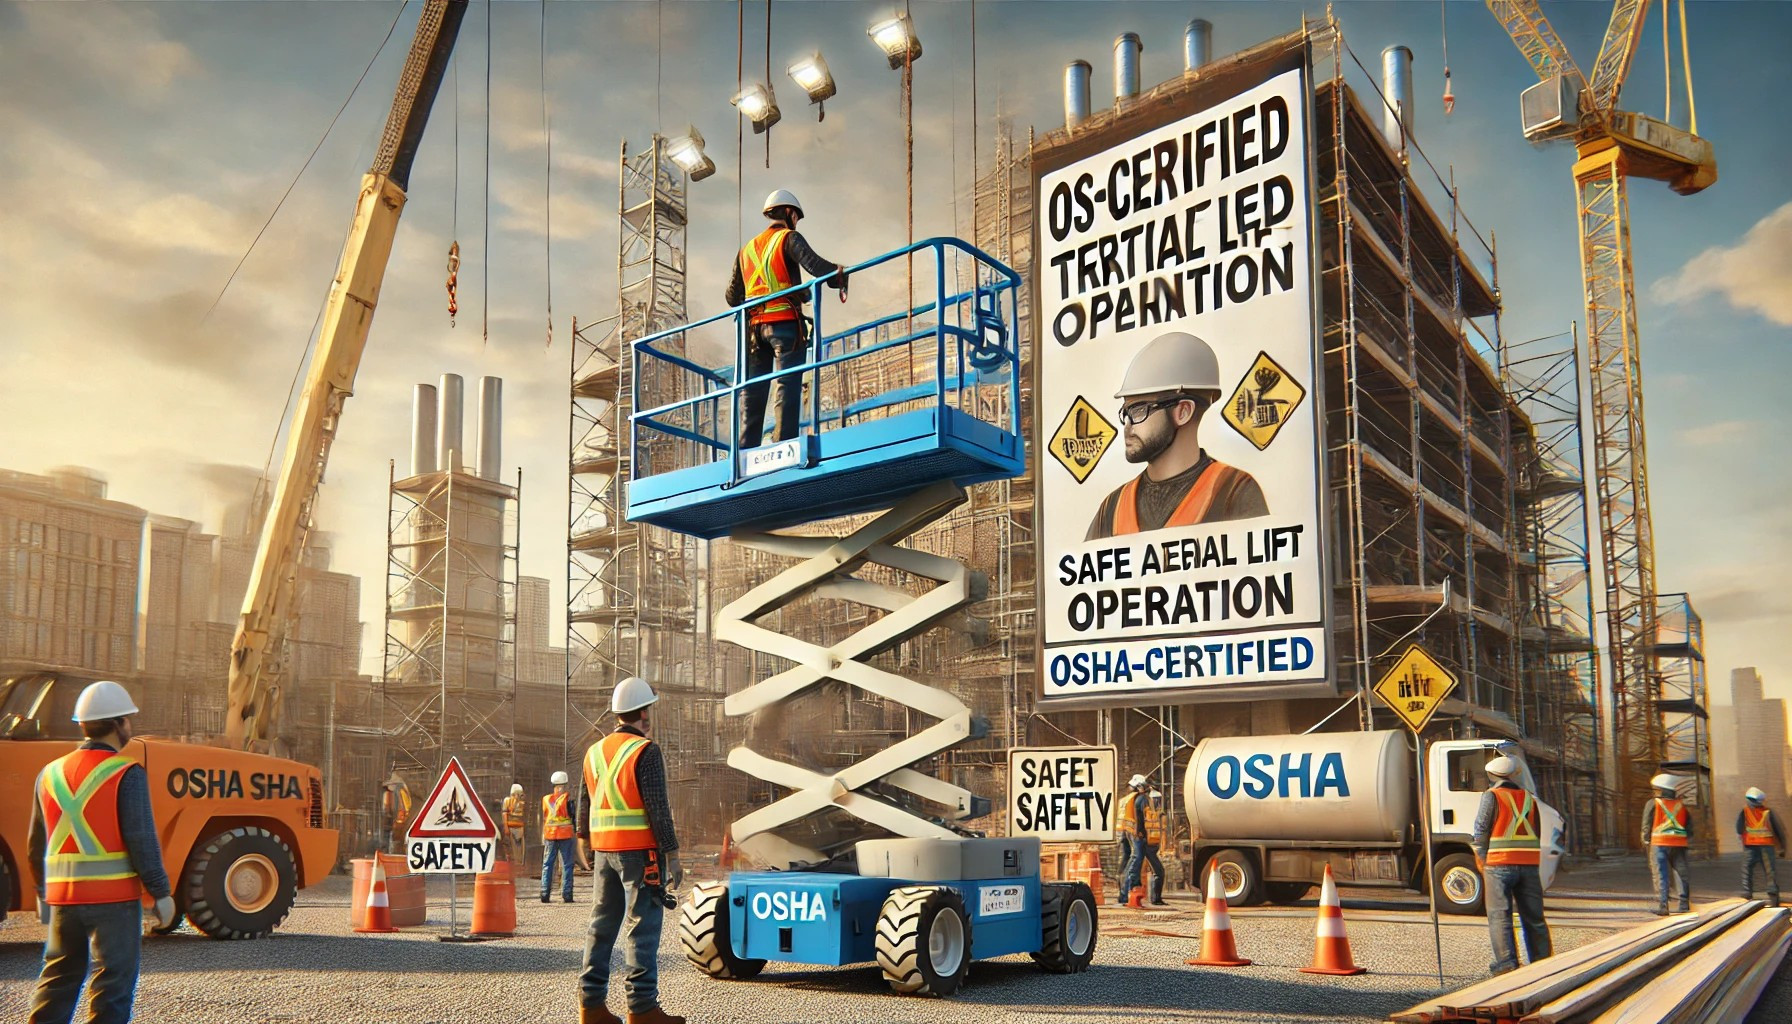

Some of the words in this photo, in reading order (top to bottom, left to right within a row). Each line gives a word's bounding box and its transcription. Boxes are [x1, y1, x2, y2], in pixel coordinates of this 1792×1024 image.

[1049, 95, 1290, 242] OS-CERIFIED
[1058, 546, 1132, 587] SAFE
[1247, 524, 1304, 566] LIFT
[1067, 571, 1294, 632] OPERATION
[1050, 636, 1314, 687] OSHA-CERTIFIED
[167, 767, 244, 799] OSHA
[250, 772, 304, 800] SHA
[1021, 757, 1099, 788] SAFET
[1207, 752, 1350, 799] OSHA
[1016, 791, 1112, 832] SAFETY
[410, 842, 491, 870] SAFETY
[752, 891, 827, 921] OSHA
